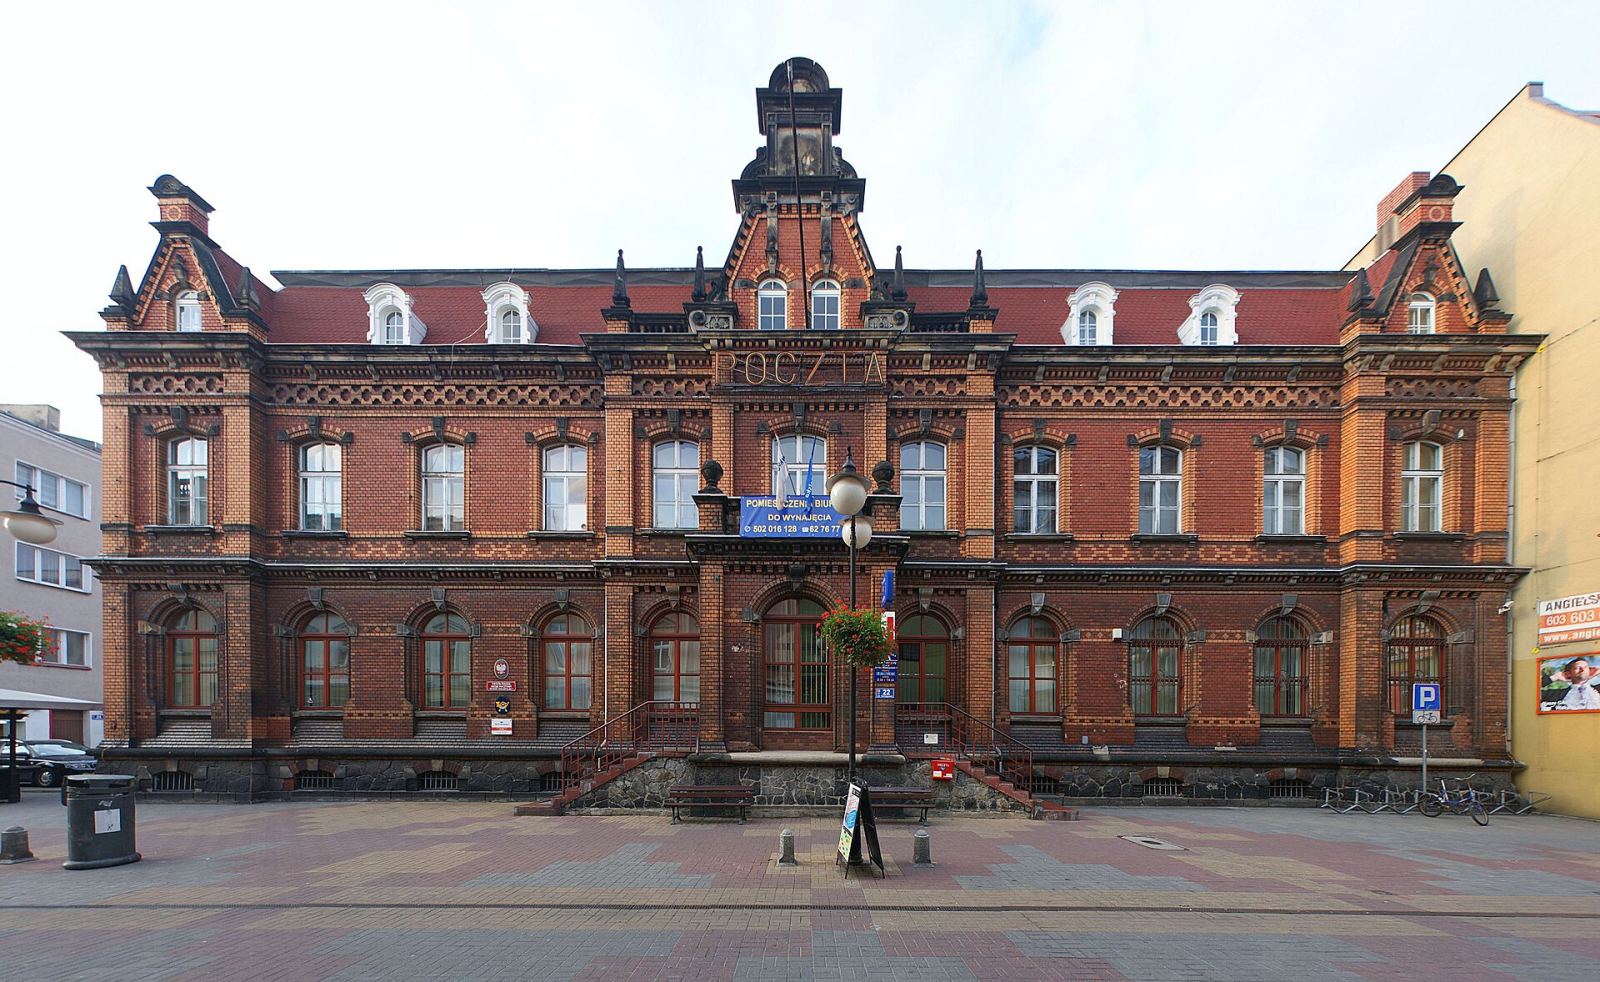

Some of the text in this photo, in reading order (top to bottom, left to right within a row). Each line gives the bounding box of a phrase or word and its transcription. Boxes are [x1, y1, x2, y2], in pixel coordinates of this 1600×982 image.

[746, 499, 813, 508] POMIESCZENI
[782, 514, 832, 522] WYNAJĘCIA
[753, 525, 767, 533] 502
[768, 525, 782, 533] 016
[784, 525, 797, 533] 128
[1546, 610, 1595, 627] 603 603
[1420, 686, 1436, 708] P
